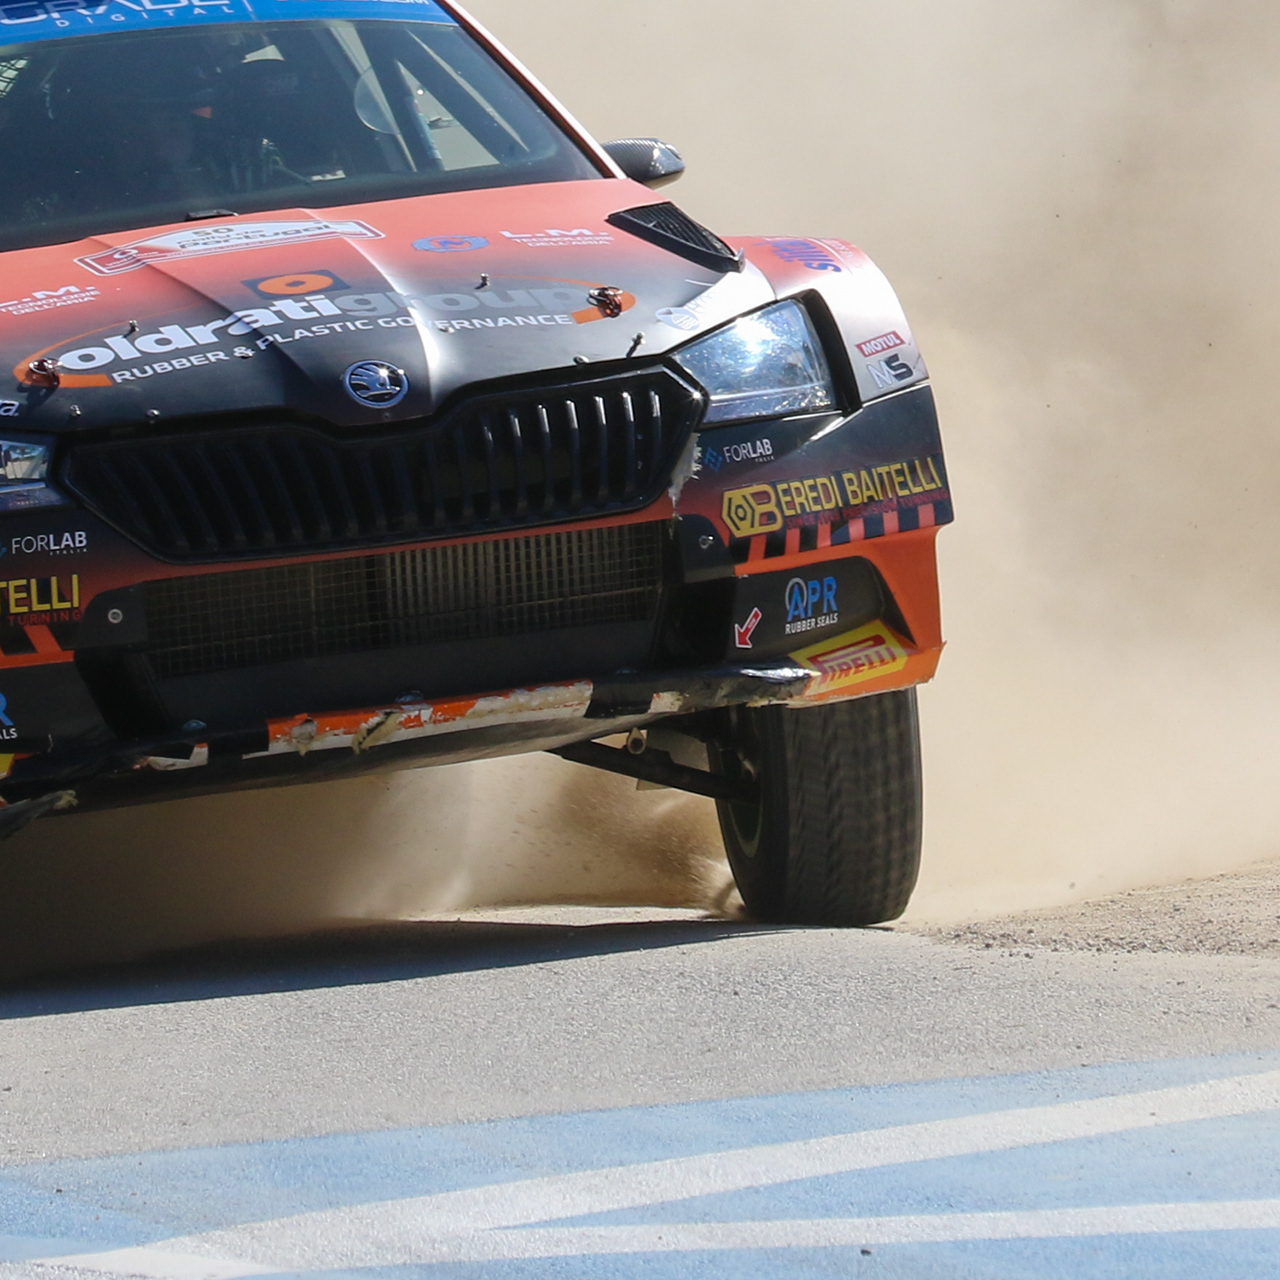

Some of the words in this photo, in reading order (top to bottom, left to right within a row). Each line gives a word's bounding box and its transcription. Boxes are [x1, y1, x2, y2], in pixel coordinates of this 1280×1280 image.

[55, 6, 235, 28] DIGITAL
[191, 226, 235, 238] 50
[110, 350, 230, 385] RUBBER
[233, 345, 256, 360] &
[255, 319, 374, 351] PLASTIC
[377, 314, 574, 332] GOVERNANCE
[860, 334, 904, 357] MOTUL
[723, 438, 773, 463] FORLAB
[775, 476, 843, 516] EREDI
[842, 457, 943, 505] BAITELLI
[11, 531, 88, 555] FORLAB
[785, 576, 838, 622] APR
[9, 610, 83, 626] TURNING
[784, 617, 815, 635] RUBBER
[816, 612, 838, 627] SEALS
[806, 634, 897, 684] PIRELLI
